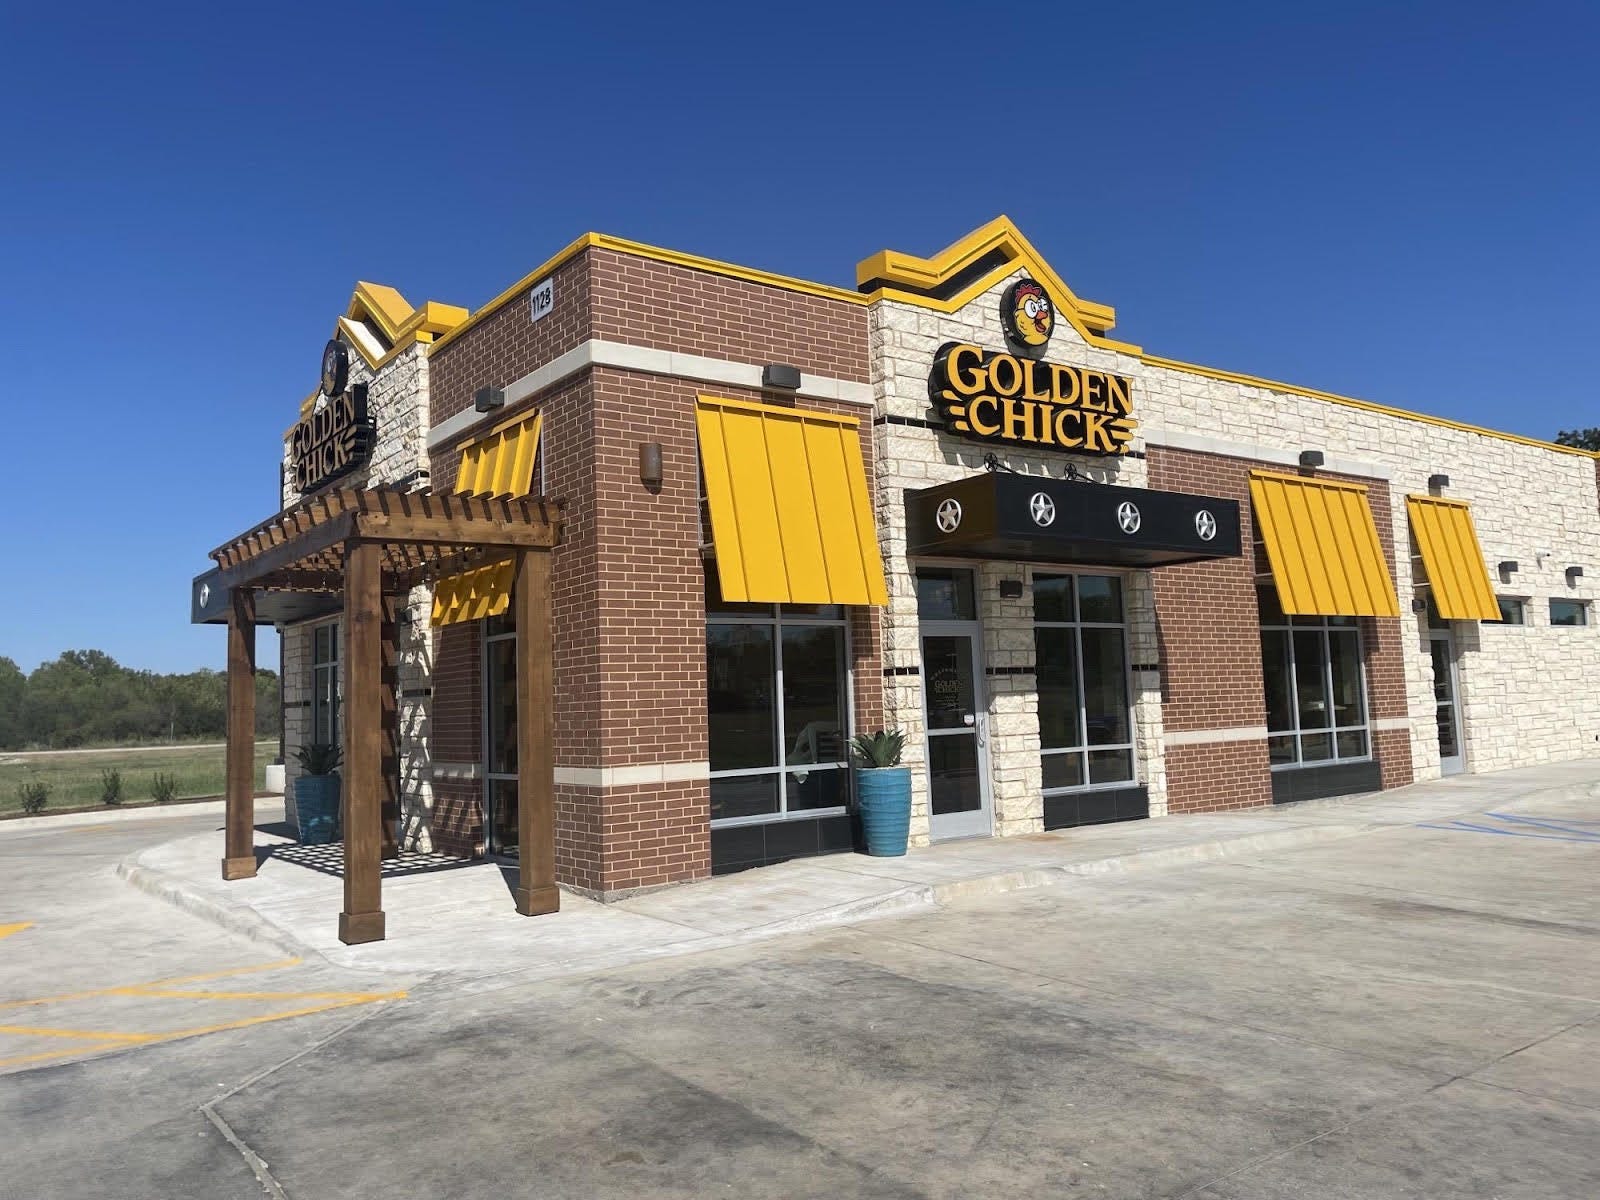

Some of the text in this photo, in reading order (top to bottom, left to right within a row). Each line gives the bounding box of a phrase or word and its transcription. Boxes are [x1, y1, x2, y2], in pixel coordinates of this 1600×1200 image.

[532, 287, 551, 316] 1128
[948, 344, 1134, 417] GOLDEN
[292, 392, 355, 464] GOLDEN
[968, 395, 1117, 453] CHICK
[295, 431, 346, 492] CHICK
